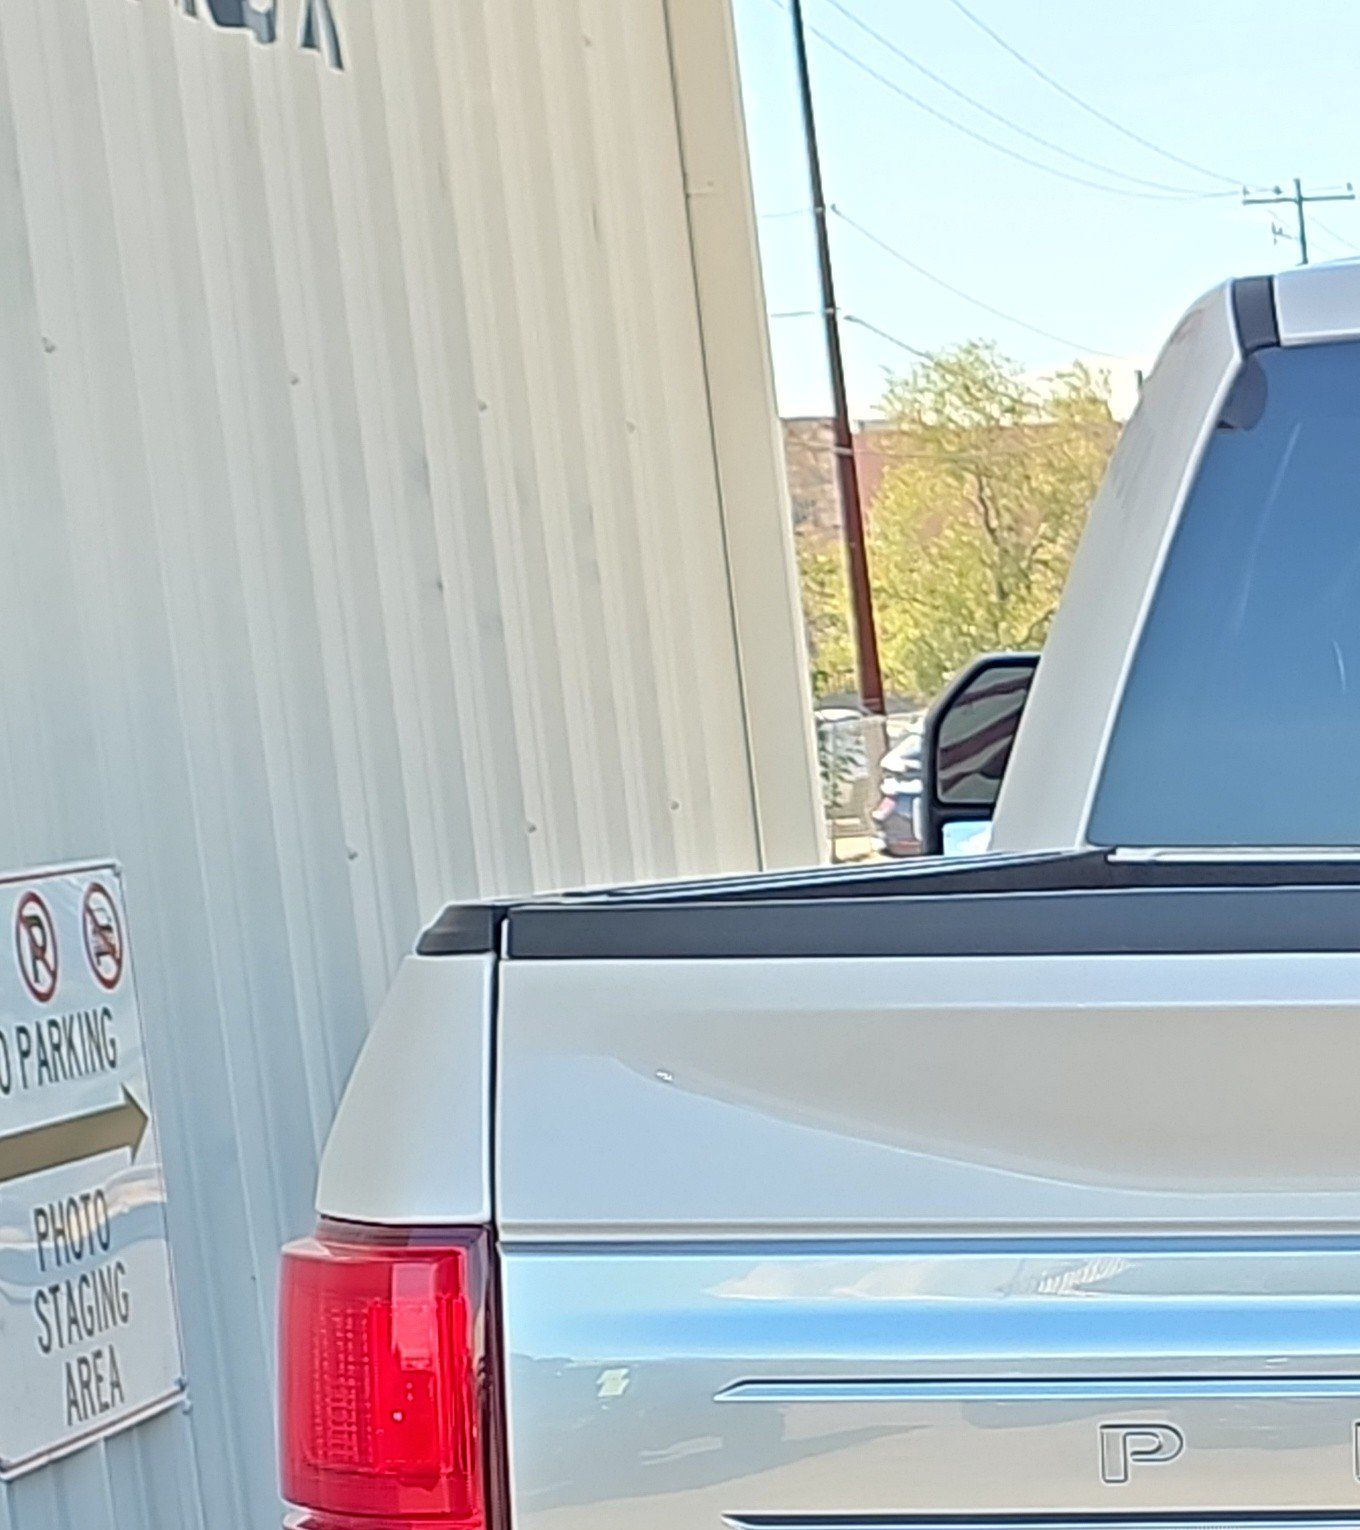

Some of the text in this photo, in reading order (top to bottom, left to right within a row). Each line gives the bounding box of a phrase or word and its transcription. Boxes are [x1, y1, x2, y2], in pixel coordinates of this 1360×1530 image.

[15, 1006, 117, 1090] PARKING
[33, 1188, 110, 1272] PHOTO
[35, 1260, 129, 1354] STAGING
[65, 1343, 124, 1426] AREA
